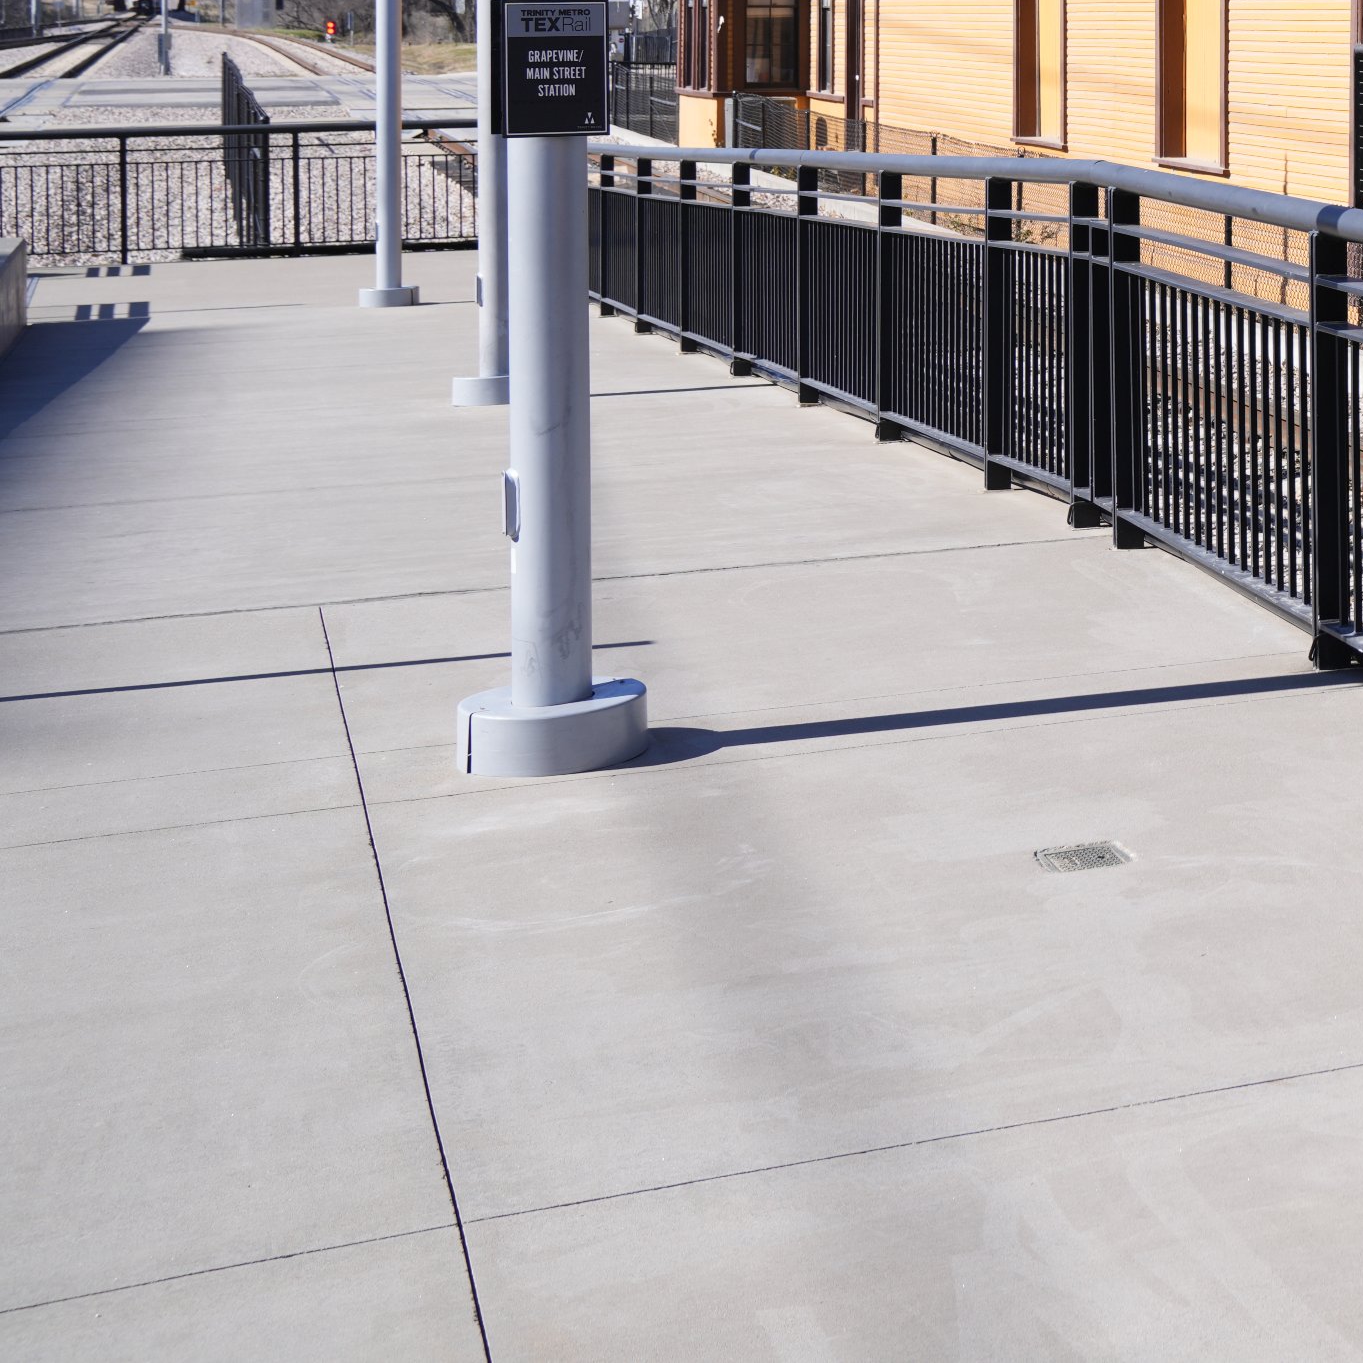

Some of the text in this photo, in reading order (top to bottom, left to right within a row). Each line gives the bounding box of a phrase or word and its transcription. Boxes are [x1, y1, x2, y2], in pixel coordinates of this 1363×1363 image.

[520, 8, 591, 17] TRINITY METRO
[528, 49, 584, 63] GRAPEVINE/
[526, 66, 587, 80] MAIN STREET
[538, 84, 576, 97] STATION
